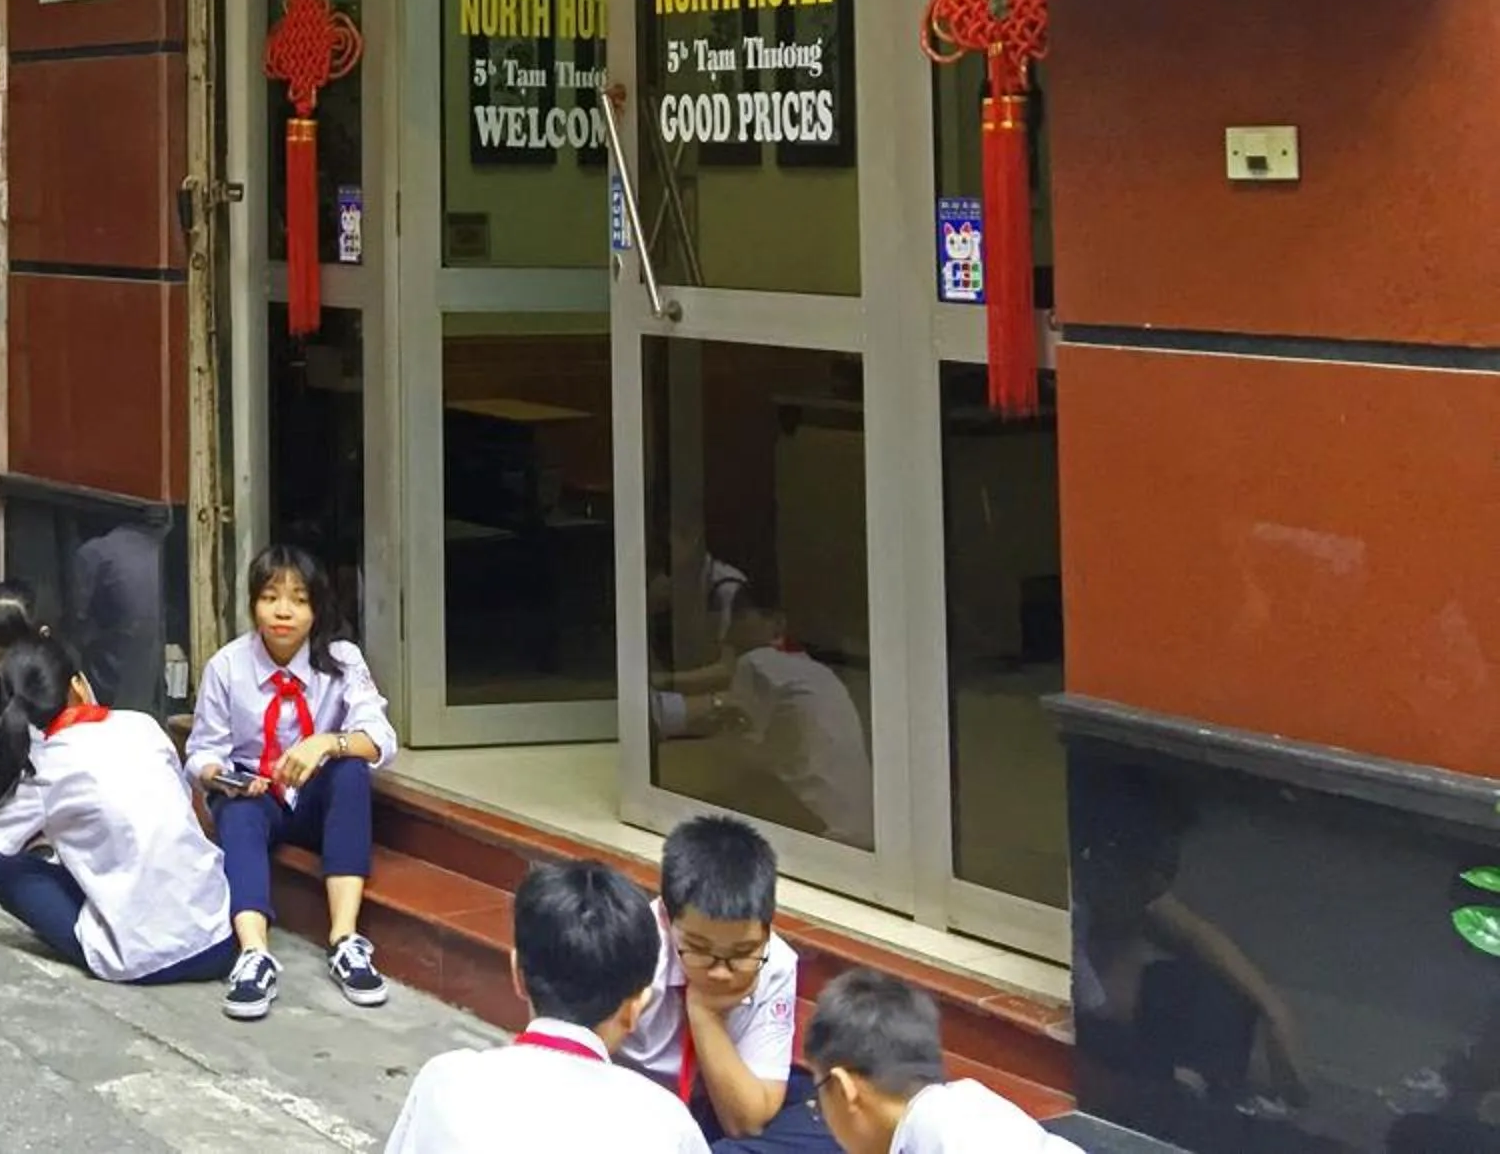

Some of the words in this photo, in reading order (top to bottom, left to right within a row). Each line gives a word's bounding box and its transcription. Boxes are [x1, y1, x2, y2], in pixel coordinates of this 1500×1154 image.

[502, 58, 548, 97] Tạm
[694, 38, 737, 82] Tạm
[473, 105, 608, 149] WELCOM
[659, 93, 732, 143] GOOD
[736, 89, 835, 143] PRICES
